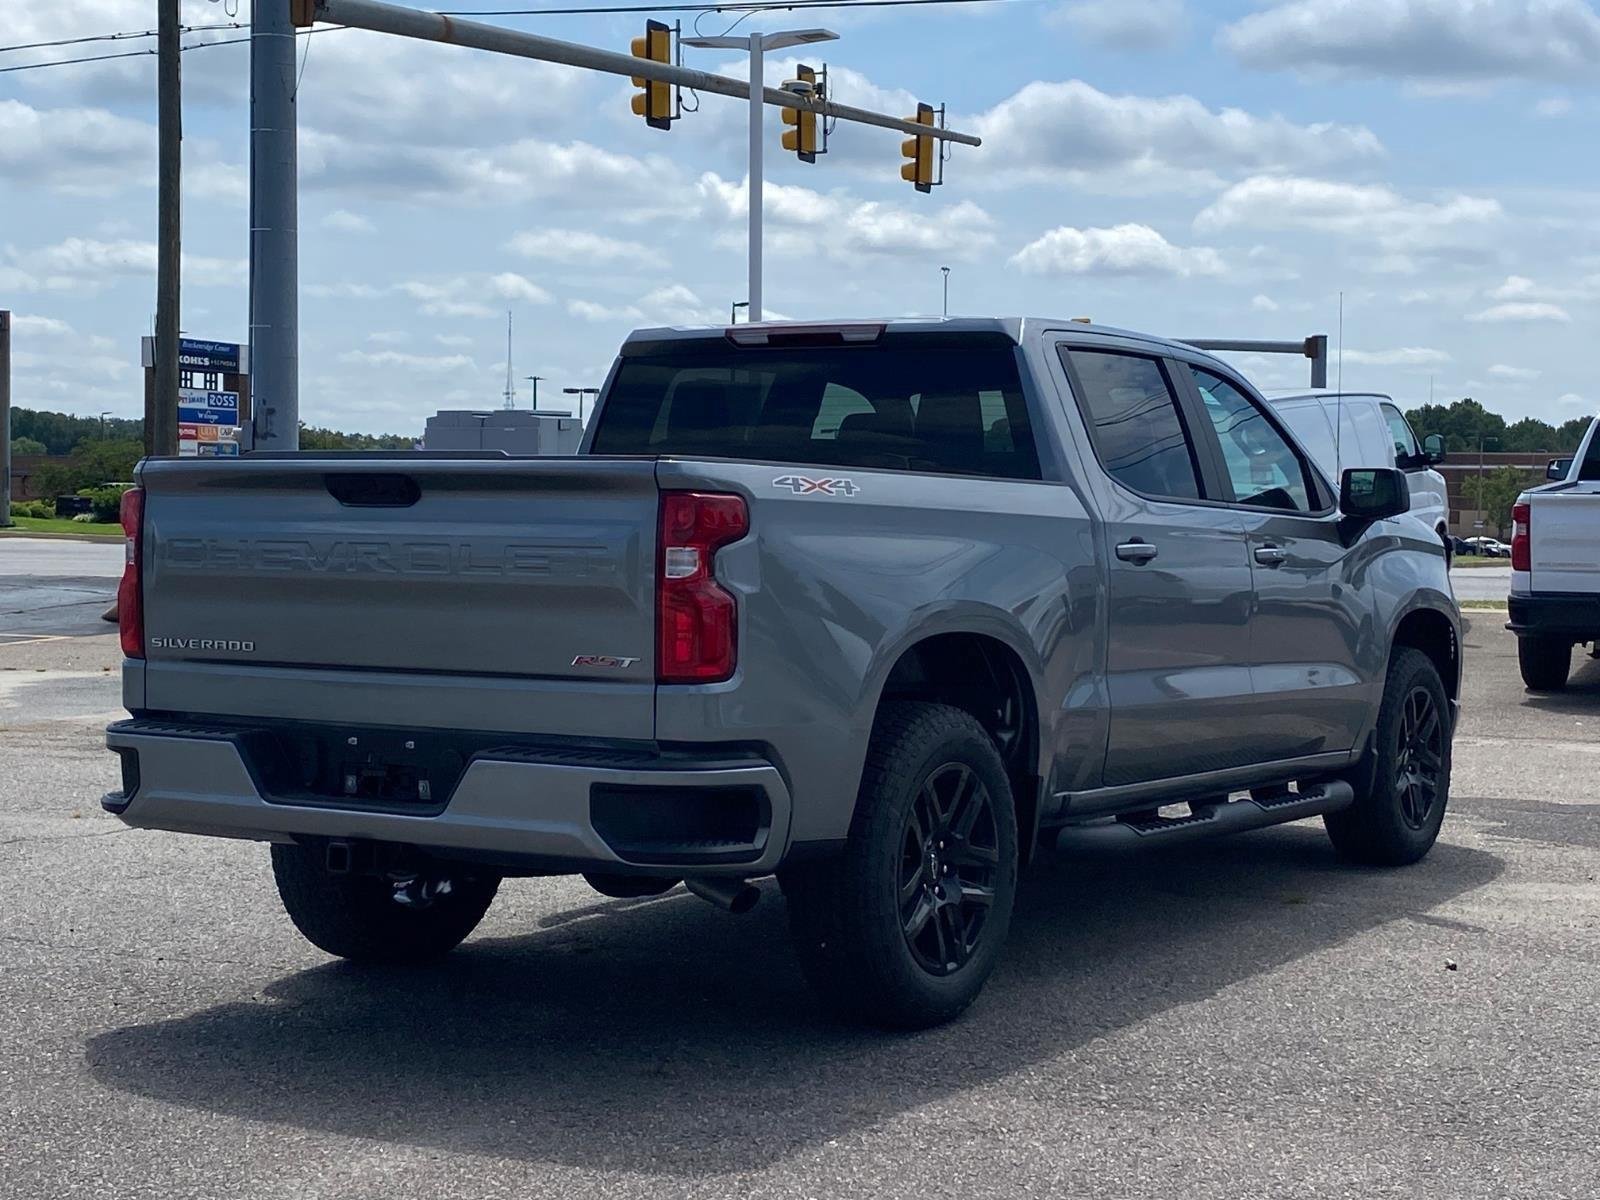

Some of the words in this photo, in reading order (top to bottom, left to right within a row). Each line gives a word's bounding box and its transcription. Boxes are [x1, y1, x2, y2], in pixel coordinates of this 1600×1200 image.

[209, 394, 235, 407] ROSS
[165, 538, 614, 577] CHEVROLET
[151, 637, 255, 652] SILVERADO
[571, 655, 641, 669] RST
